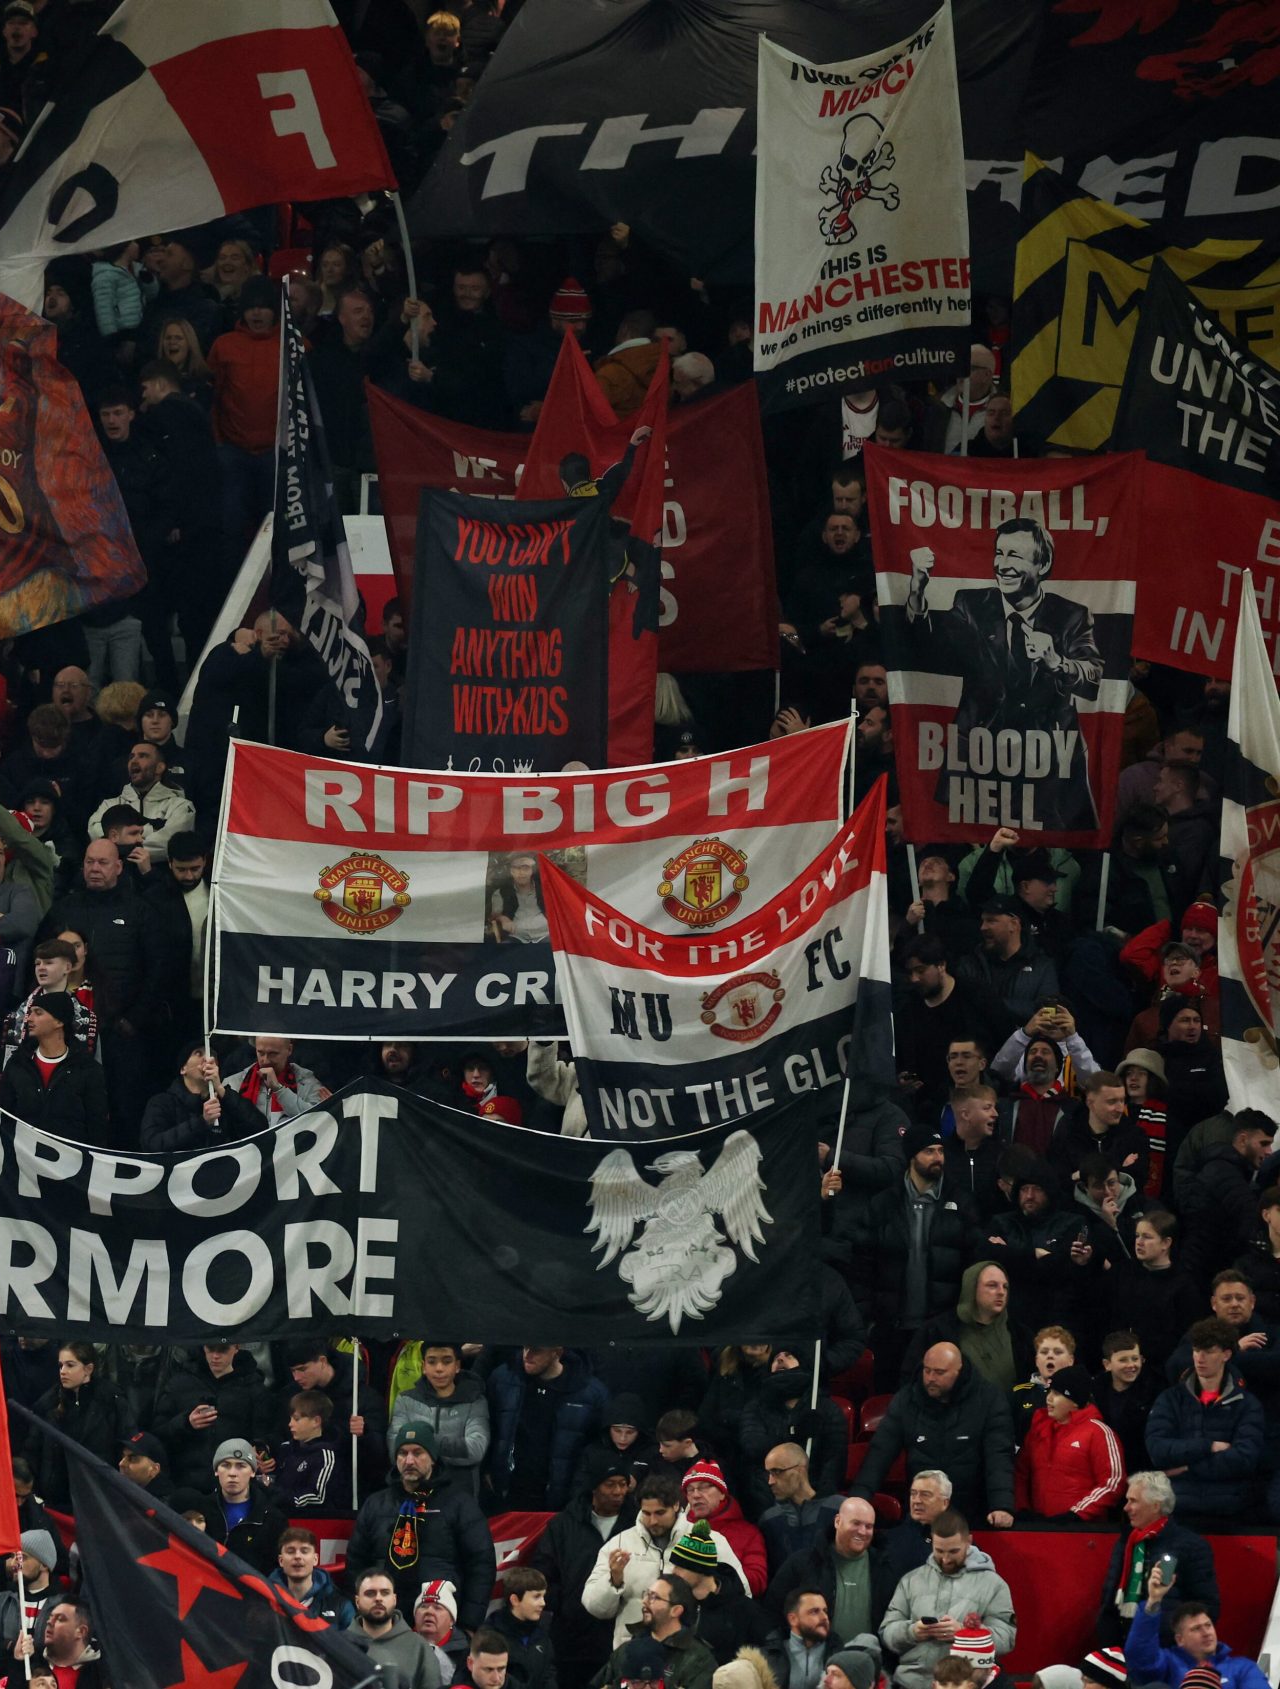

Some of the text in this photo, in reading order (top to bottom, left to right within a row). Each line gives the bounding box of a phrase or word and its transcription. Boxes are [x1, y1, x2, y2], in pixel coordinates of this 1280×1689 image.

[459, 107, 757, 200] TH
[820, 245, 888, 280] THIS IS
[802, 313, 852, 340] things
[856, 295, 943, 324] differently
[947, 297, 970, 312] her
[785, 347, 956, 394] #protectfanculture
[1176, 400, 1273, 474] THE
[888, 476, 1110, 537] FOOTBALL,
[454, 516, 508, 566] YOU
[488, 573, 539, 623] WIN
[451, 627, 563, 679] ANYTHING
[918, 721, 1078, 779] BLOODY
[303, 754, 771, 835] RIP BIG H
[948, 776, 1044, 831] HELL
[326, 860, 401, 889] MANCHESTER
[669, 843, 740, 875] MANCHESTER
[336, 911, 389, 928] UNITED
[677, 905, 728, 922] UNITED
[689, 925, 766, 965] THE
[777, 831, 859, 933] LOVE
[256, 965, 556, 1010] HARRY CR
[608, 926, 852, 1042] MU FC
[598, 1084, 679, 1131] NOT
[684, 1066, 776, 1127] THE
